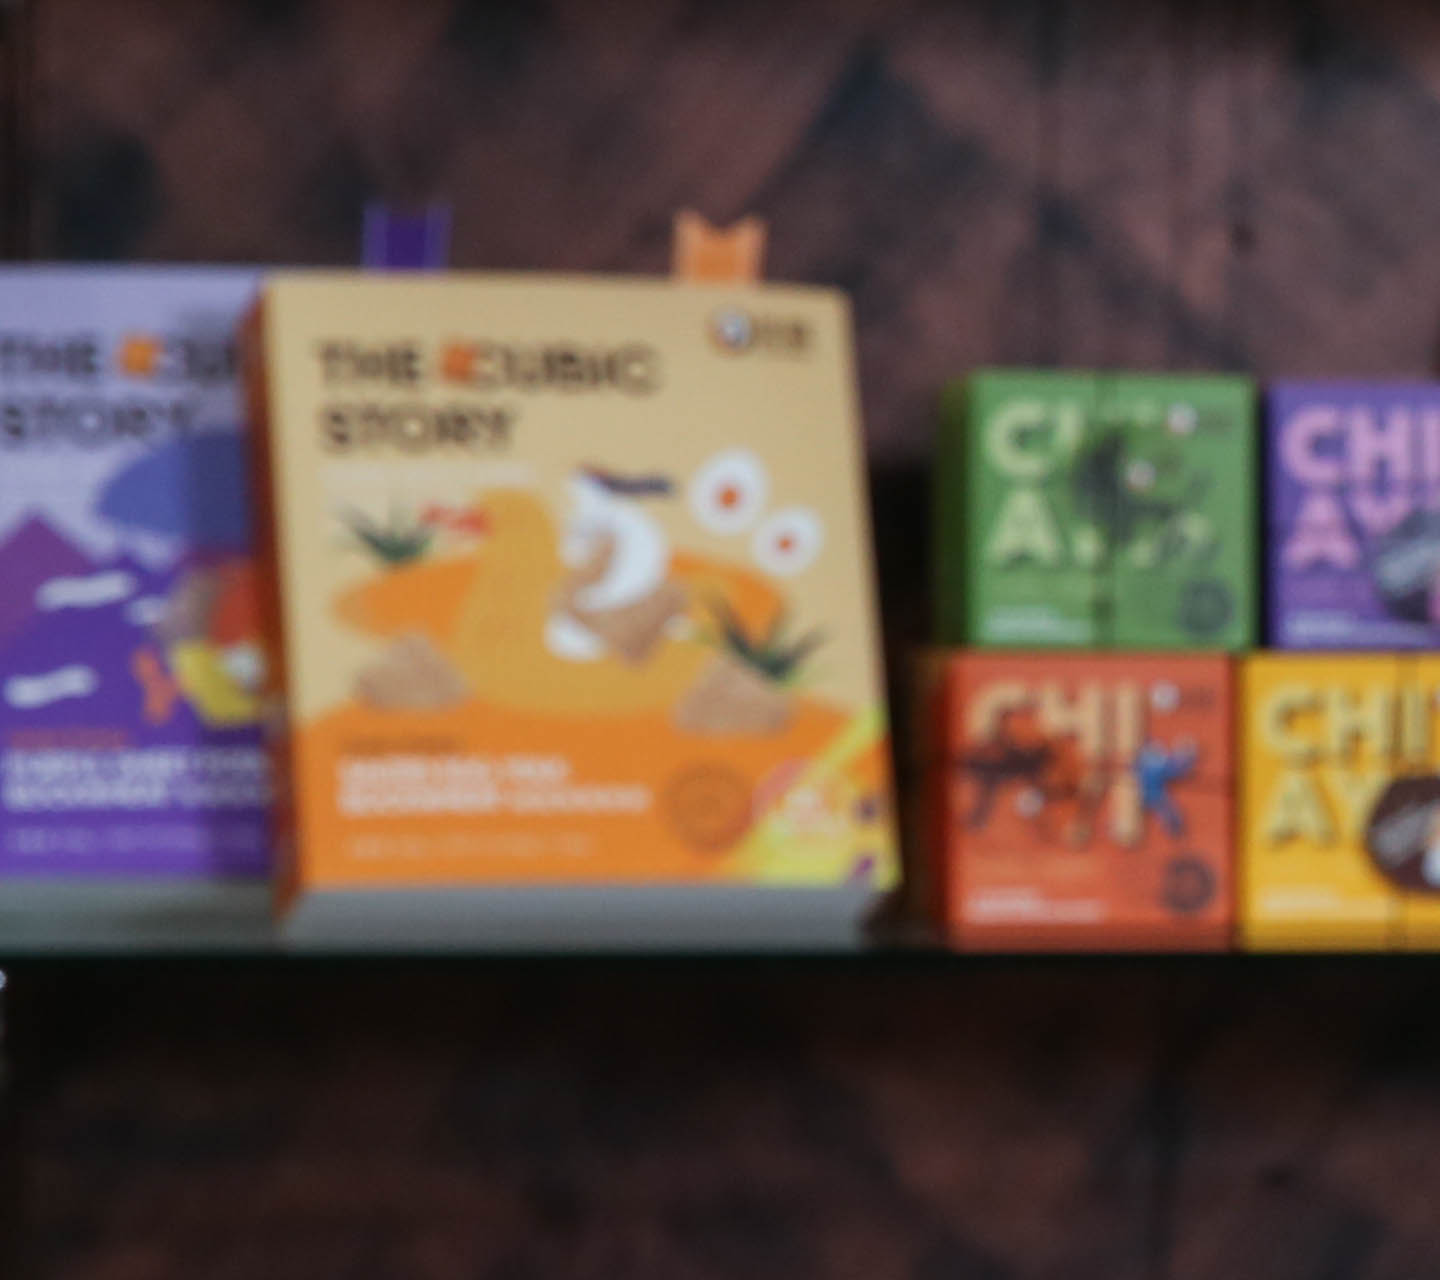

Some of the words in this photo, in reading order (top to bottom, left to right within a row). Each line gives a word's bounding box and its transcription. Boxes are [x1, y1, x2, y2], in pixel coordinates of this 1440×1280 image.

[314, 338, 426, 388] THE
[320, 400, 518, 451] STORY
[1266, 683, 1432, 760] CHI
